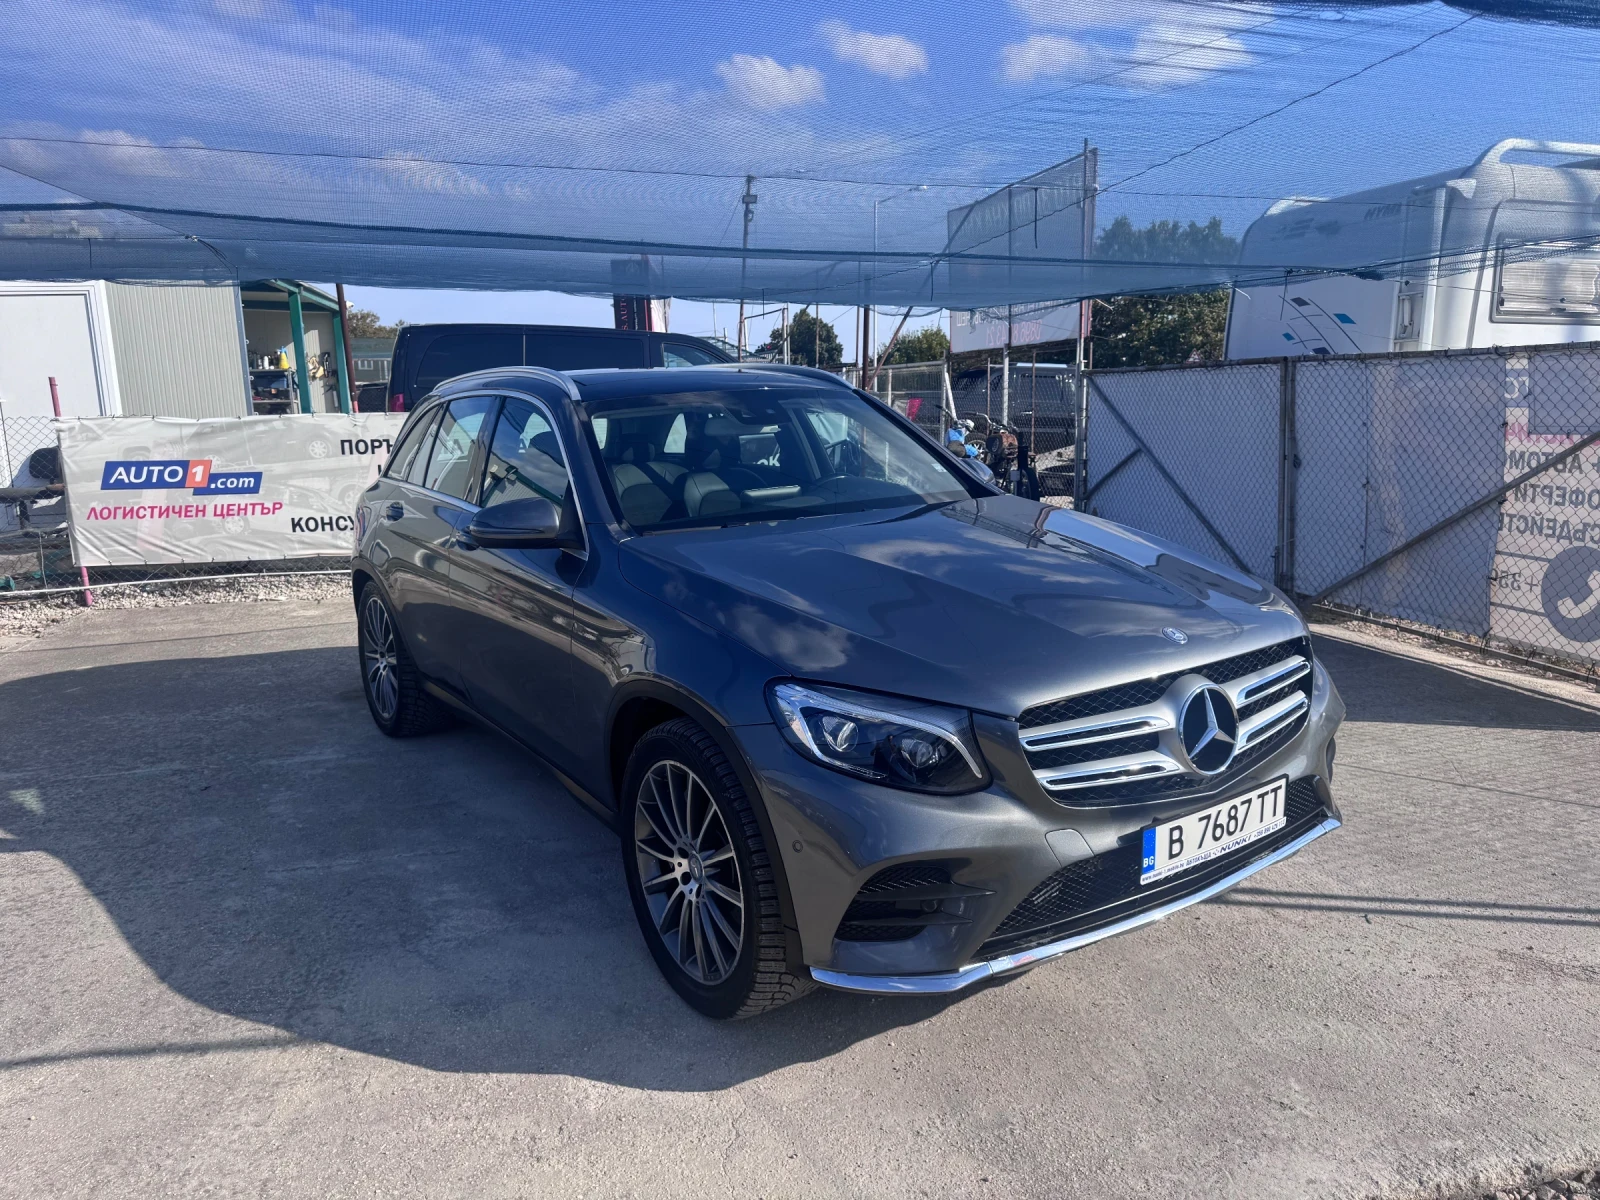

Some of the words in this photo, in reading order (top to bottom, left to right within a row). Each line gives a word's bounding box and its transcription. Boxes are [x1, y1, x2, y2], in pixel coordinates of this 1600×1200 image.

[86, 504, 207, 521] ЛОГИСТИЧЕН
[213, 502, 283, 519] ЦЕНТЪР
[1168, 824, 1184, 860] B
[1197, 798, 1252, 849] 7687
[1257, 785, 1282, 823] TT
[1219, 834, 1252, 853] NUNKI
[1143, 855, 1155, 868] BG
